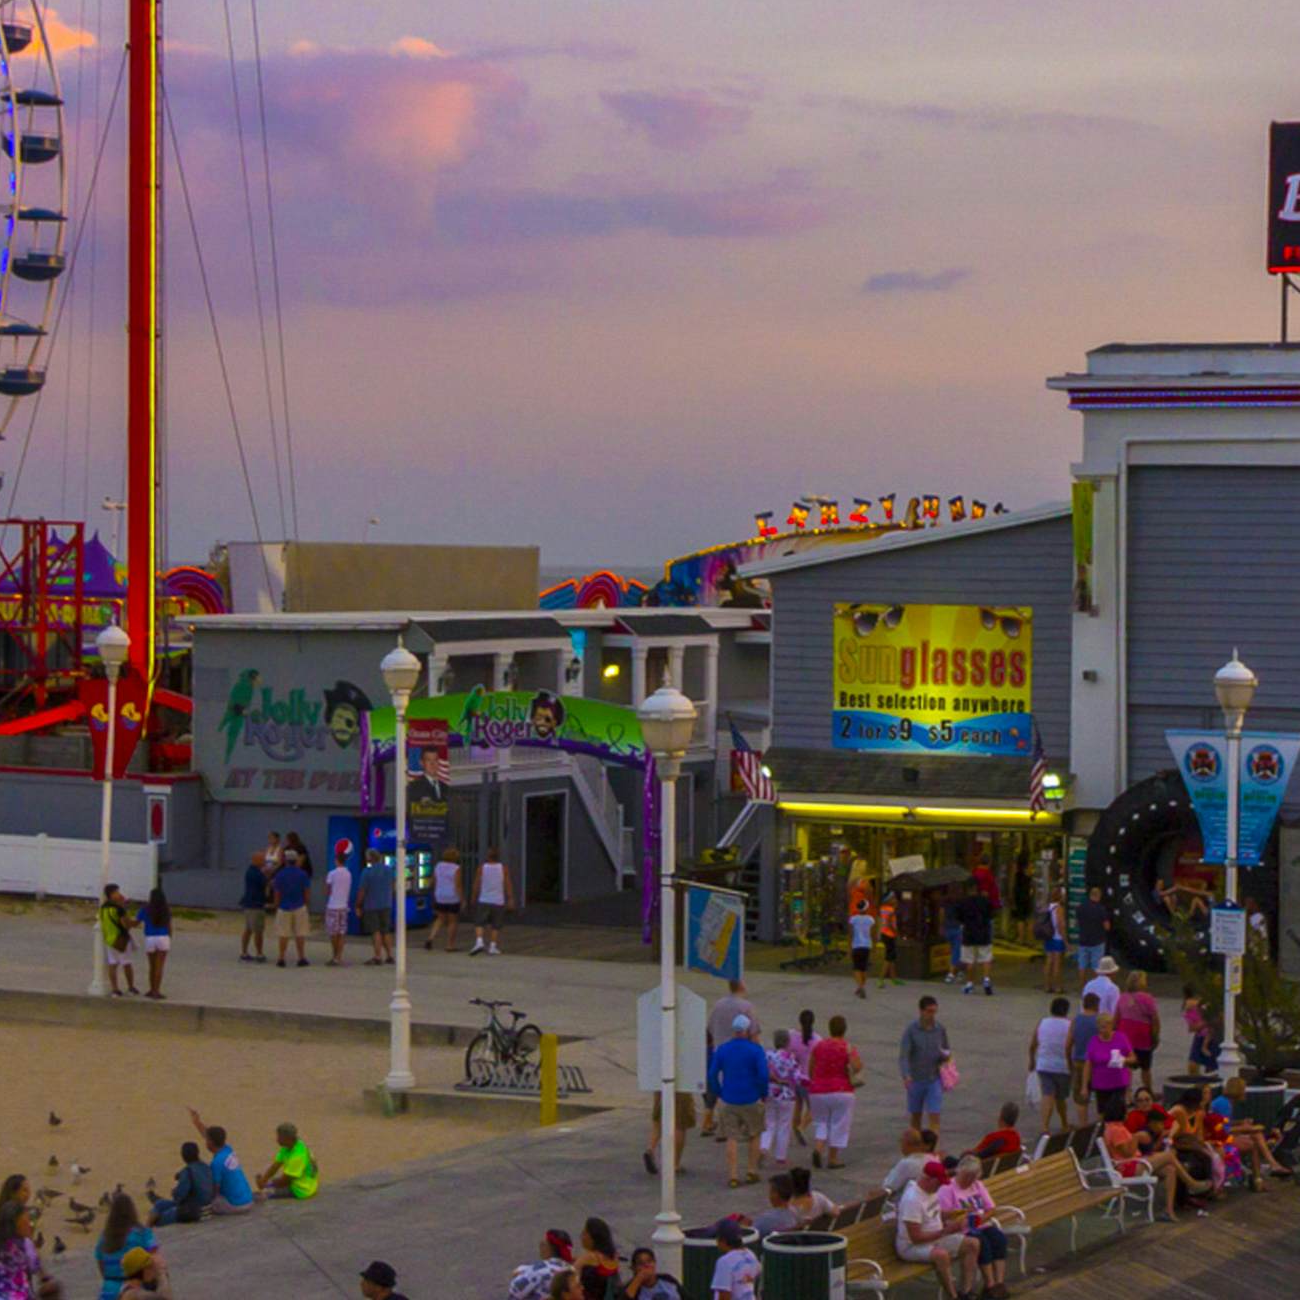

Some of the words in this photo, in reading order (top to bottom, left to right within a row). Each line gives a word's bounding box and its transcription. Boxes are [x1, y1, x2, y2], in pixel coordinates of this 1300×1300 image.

[838, 637, 1026, 690] Sunglasses
[487, 697, 530, 721] Jolly
[839, 692, 871, 708] Best
[877, 693, 946, 710] selection
[953, 696, 1025, 714] anywhere
[474, 714, 534, 747] Roger
[841, 716, 852, 739] 2
[859, 723, 882, 740] for
[888, 717, 913, 741] $9
[929, 719, 953, 742] $5
